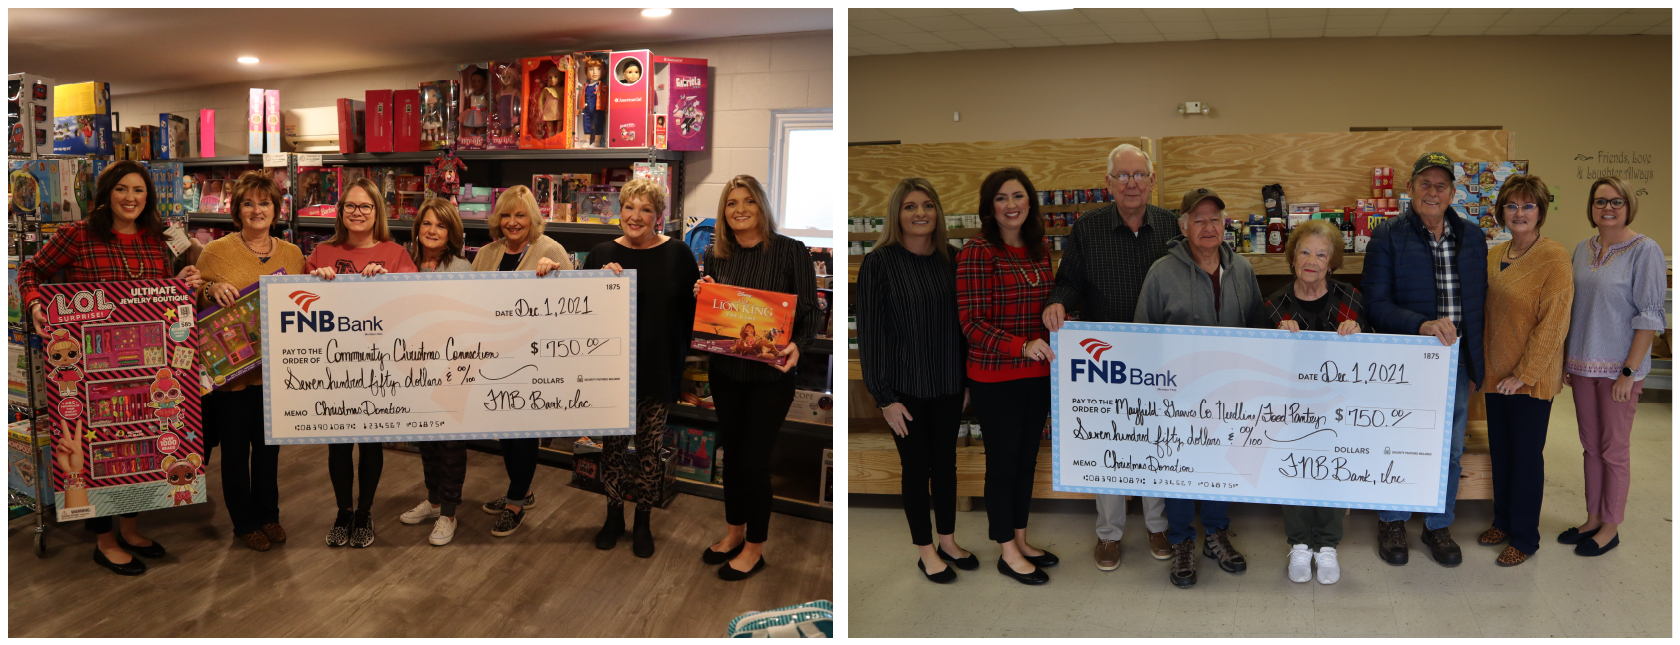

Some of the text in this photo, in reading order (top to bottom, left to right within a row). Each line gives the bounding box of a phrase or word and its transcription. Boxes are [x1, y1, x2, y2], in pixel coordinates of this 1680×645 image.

[1598, 150, 1652, 165] Friends, Love
[1577, 165, 1583, 179] &
[1624, 166, 1654, 183] Always
[320, 206, 336, 216] Barbie
[120, 295, 189, 305] JEWELRY BOUTIQUE
[131, 286, 177, 297] ULTIMATE
[514, 298, 543, 317] Dec.
[712, 299, 774, 318] LION KING
[58, 312, 104, 323] SURPRISE!
[280, 310, 384, 333] FNB Bank
[326, 337, 500, 371] Community Christmas Connection
[530, 341, 538, 356] $
[1424, 352, 1440, 360] 1875
[284, 366, 326, 391] Seven
[404, 368, 442, 388] dollars
[1071, 358, 1178, 387] FNB Bank
[314, 400, 410, 416] Christmas Donation
[484, 389, 526, 411] FNB
[1289, 402, 1326, 429] Pantry
[1335, 408, 1344, 422] $
[1073, 416, 1112, 440] Seven
[1187, 424, 1221, 446] dollars
[1334, 446, 1370, 454] DOLLARS
[1104, 449, 1194, 473] Christmas Donation
[1278, 452, 1329, 480] FNB
